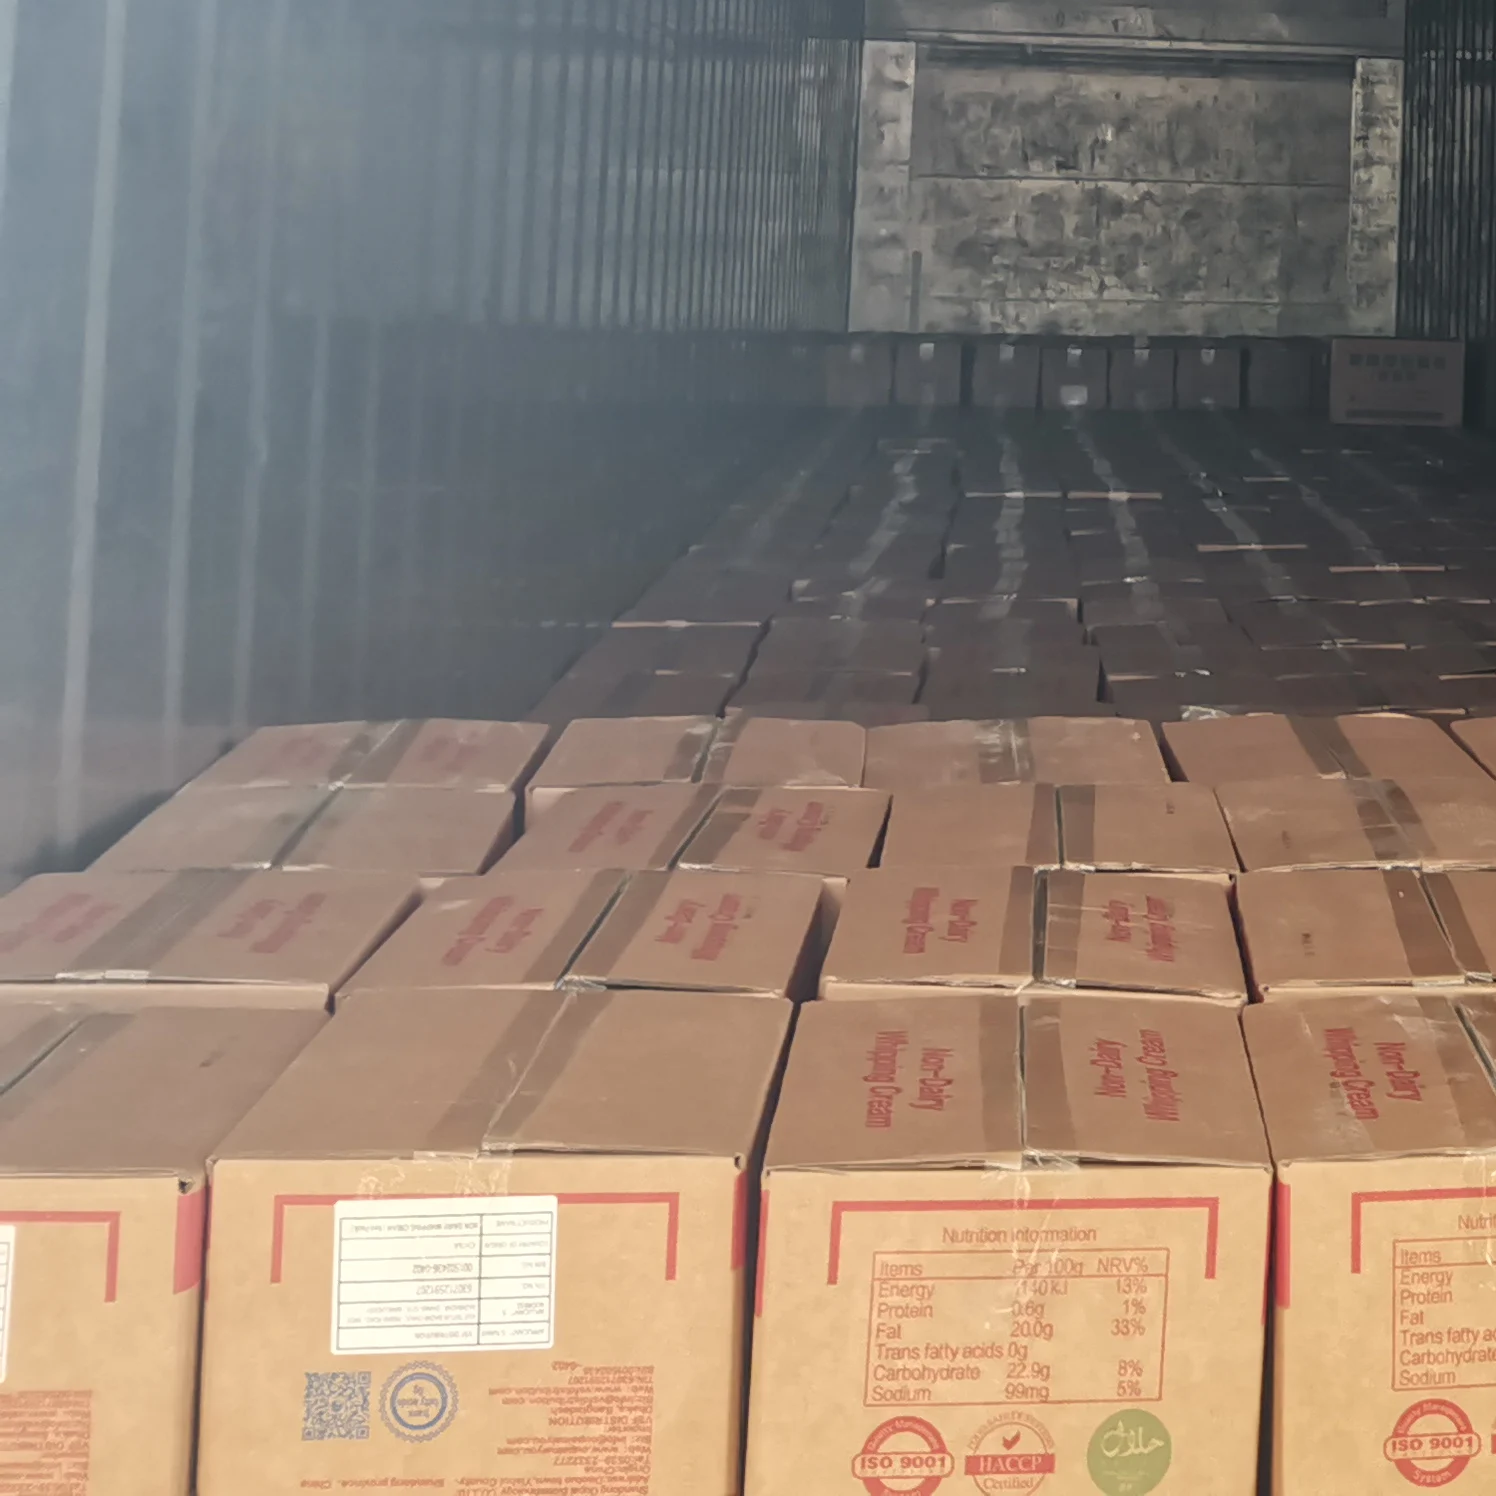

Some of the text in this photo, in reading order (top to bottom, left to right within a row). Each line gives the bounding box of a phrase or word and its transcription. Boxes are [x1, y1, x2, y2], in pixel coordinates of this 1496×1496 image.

[909, 1047, 953, 1111] Non-Dairy
[1374, 1041, 1424, 1101] Non-Dairy
[864, 1085, 902, 1127] Cream
[1342, 1079, 1380, 1120] Cream
[942, 1227, 1007, 1245] Nutrition
[1400, 1248, 1442, 1264] Items
[880, 1261, 922, 1276] Items
[1046, 1261, 1083, 1277] 100g
[1097, 1257, 1149, 1274] NRV%
[1117, 1280, 1147, 1294] 13%
[1400, 1271, 1452, 1288] Energy
[880, 1283, 934, 1301] Energy
[1400, 1289, 1452, 1304] Protein
[878, 1303, 934, 1318] Protein
[1011, 1303, 1044, 1321] 0.6g
[1123, 1299, 1146, 1315] 1%
[1401, 1309, 1424, 1325] Fat
[876, 1323, 901, 1339] Fat
[1010, 1321, 1053, 1340] 20.0g
[1111, 1319, 1145, 1335] 33%
[1401, 1329, 1445, 1345] Trans
[1447, 1326, 1480, 1345] fatty
[876, 1343, 1004, 1361] Trans fatty acids
[1007, 1343, 1028, 1362] 0g
[873, 1364, 980, 1382] Carbohydrate
[1007, 1363, 1050, 1380] 22.9g
[1118, 1361, 1143, 1377] 8%
[1399, 1369, 1456, 1386] Sodium
[872, 1385, 931, 1402] Sodium
[1005, 1383, 1050, 1402] 99mg
[1117, 1381, 1141, 1397] 5%
[1391, 1435, 1473, 1453] ISO 9001
[859, 1454, 946, 1470] ISO 9001
[980, 1456, 1042, 1472] HACCP
[983, 1476, 1034, 1491] Certified
